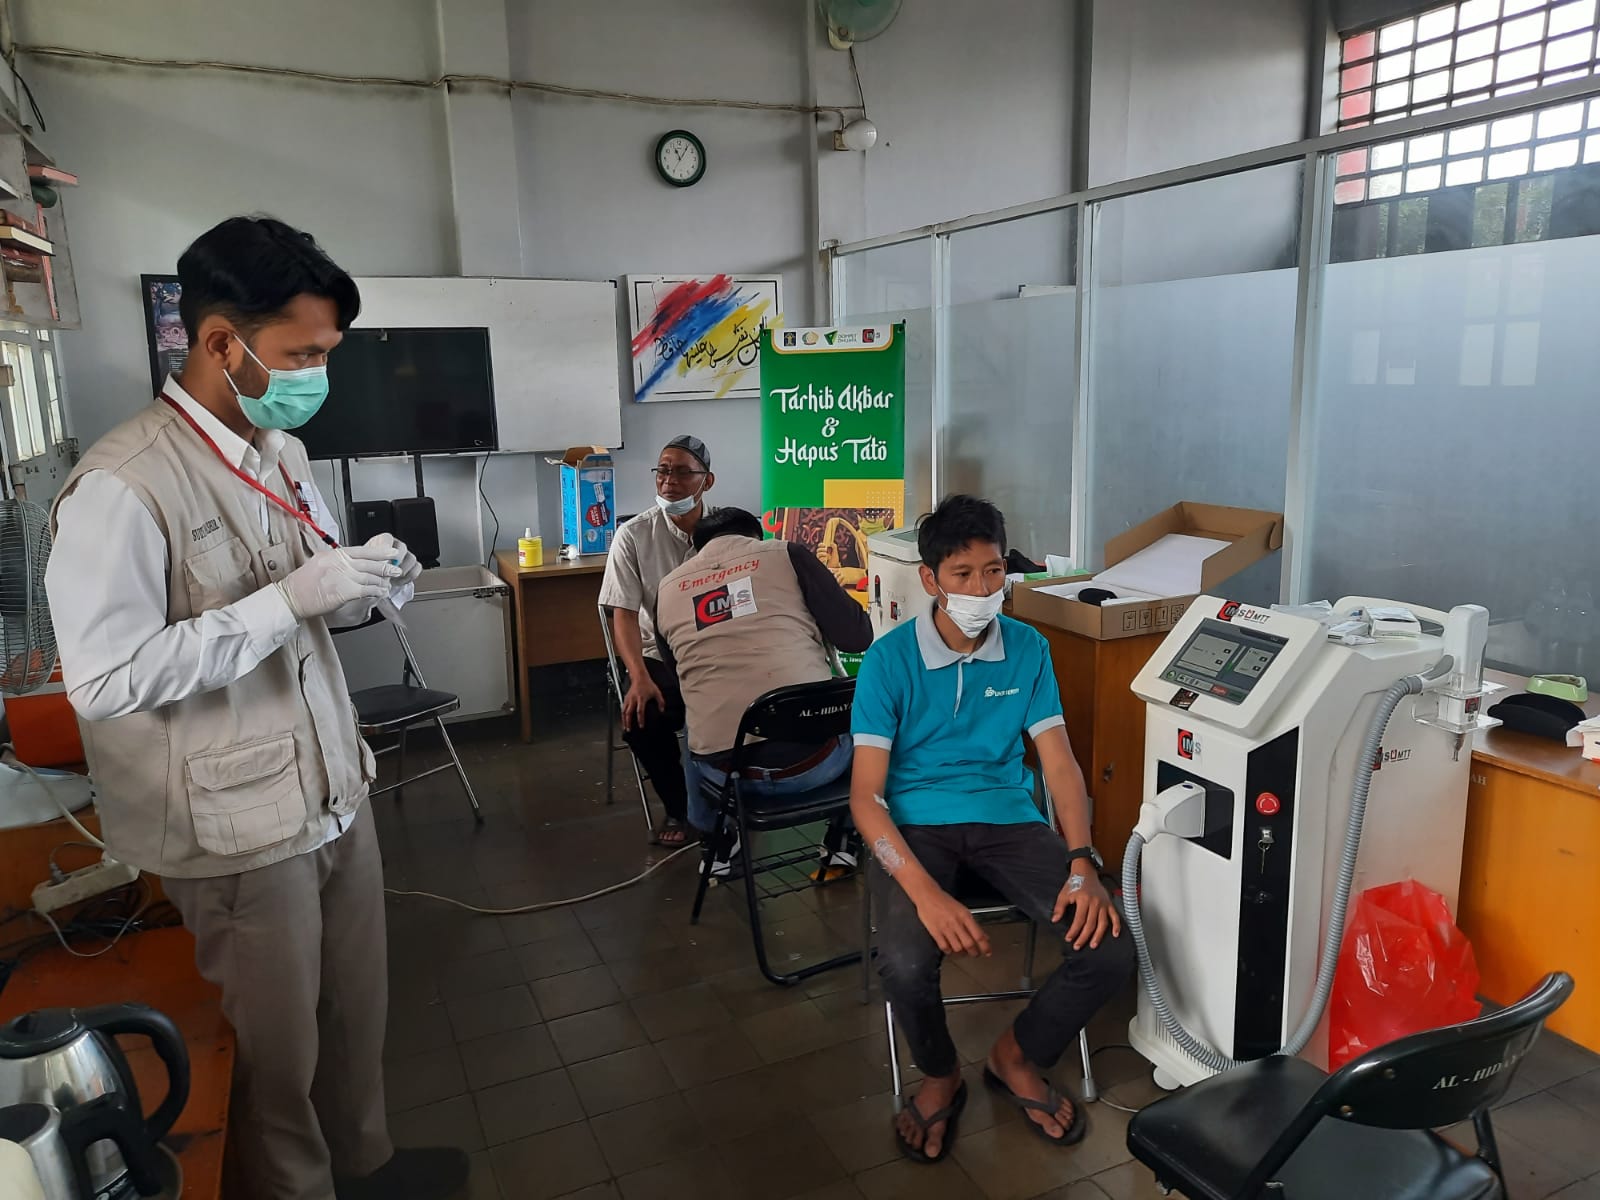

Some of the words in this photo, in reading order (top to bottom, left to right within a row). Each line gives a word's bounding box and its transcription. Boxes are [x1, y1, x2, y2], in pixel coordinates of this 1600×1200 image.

[769, 383, 834, 414] Tarhib
[837, 383, 894, 414] Akbar
[821, 416, 840, 437] &
[774, 436, 839, 469] Hapus
[679, 559, 760, 592] Emergency
